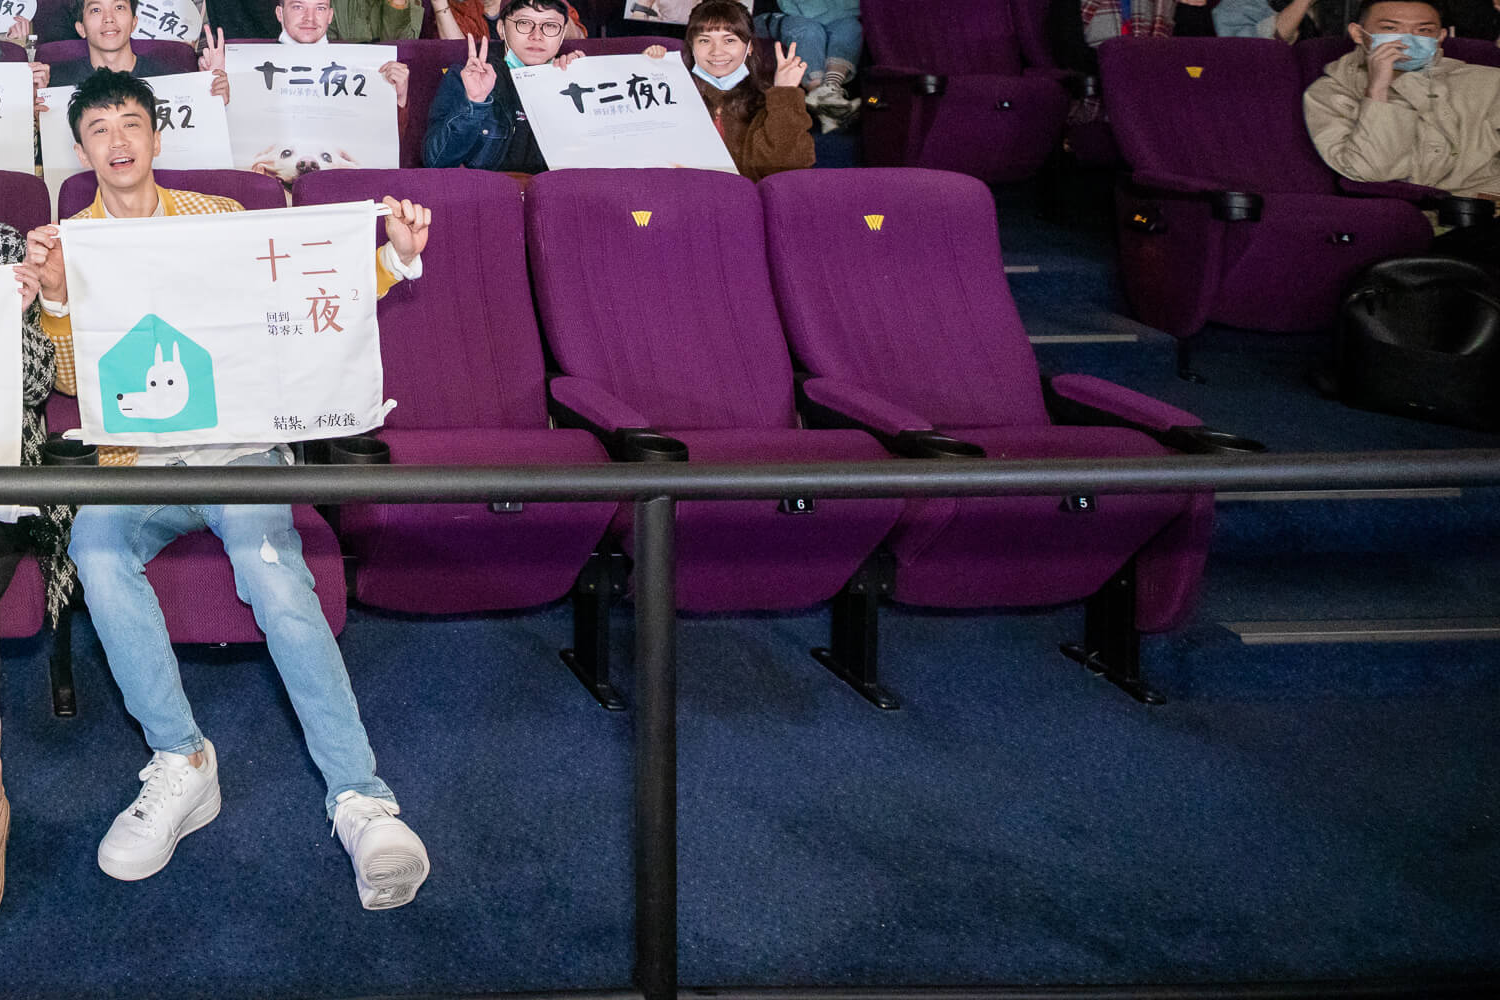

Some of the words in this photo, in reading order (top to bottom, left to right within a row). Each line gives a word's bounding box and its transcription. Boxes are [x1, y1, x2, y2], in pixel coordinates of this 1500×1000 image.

[137, 2, 189, 40] 二夜2
[255, 60, 367, 97] 十二夜2
[559, 72, 678, 114] 十二夜2
[153, 98, 194, 132] 夜2
[266, 311, 289, 323] 回到
[267, 324, 303, 336] 第零天
[797, 499, 805, 510] 6
[1079, 497, 1088, 508] 5
